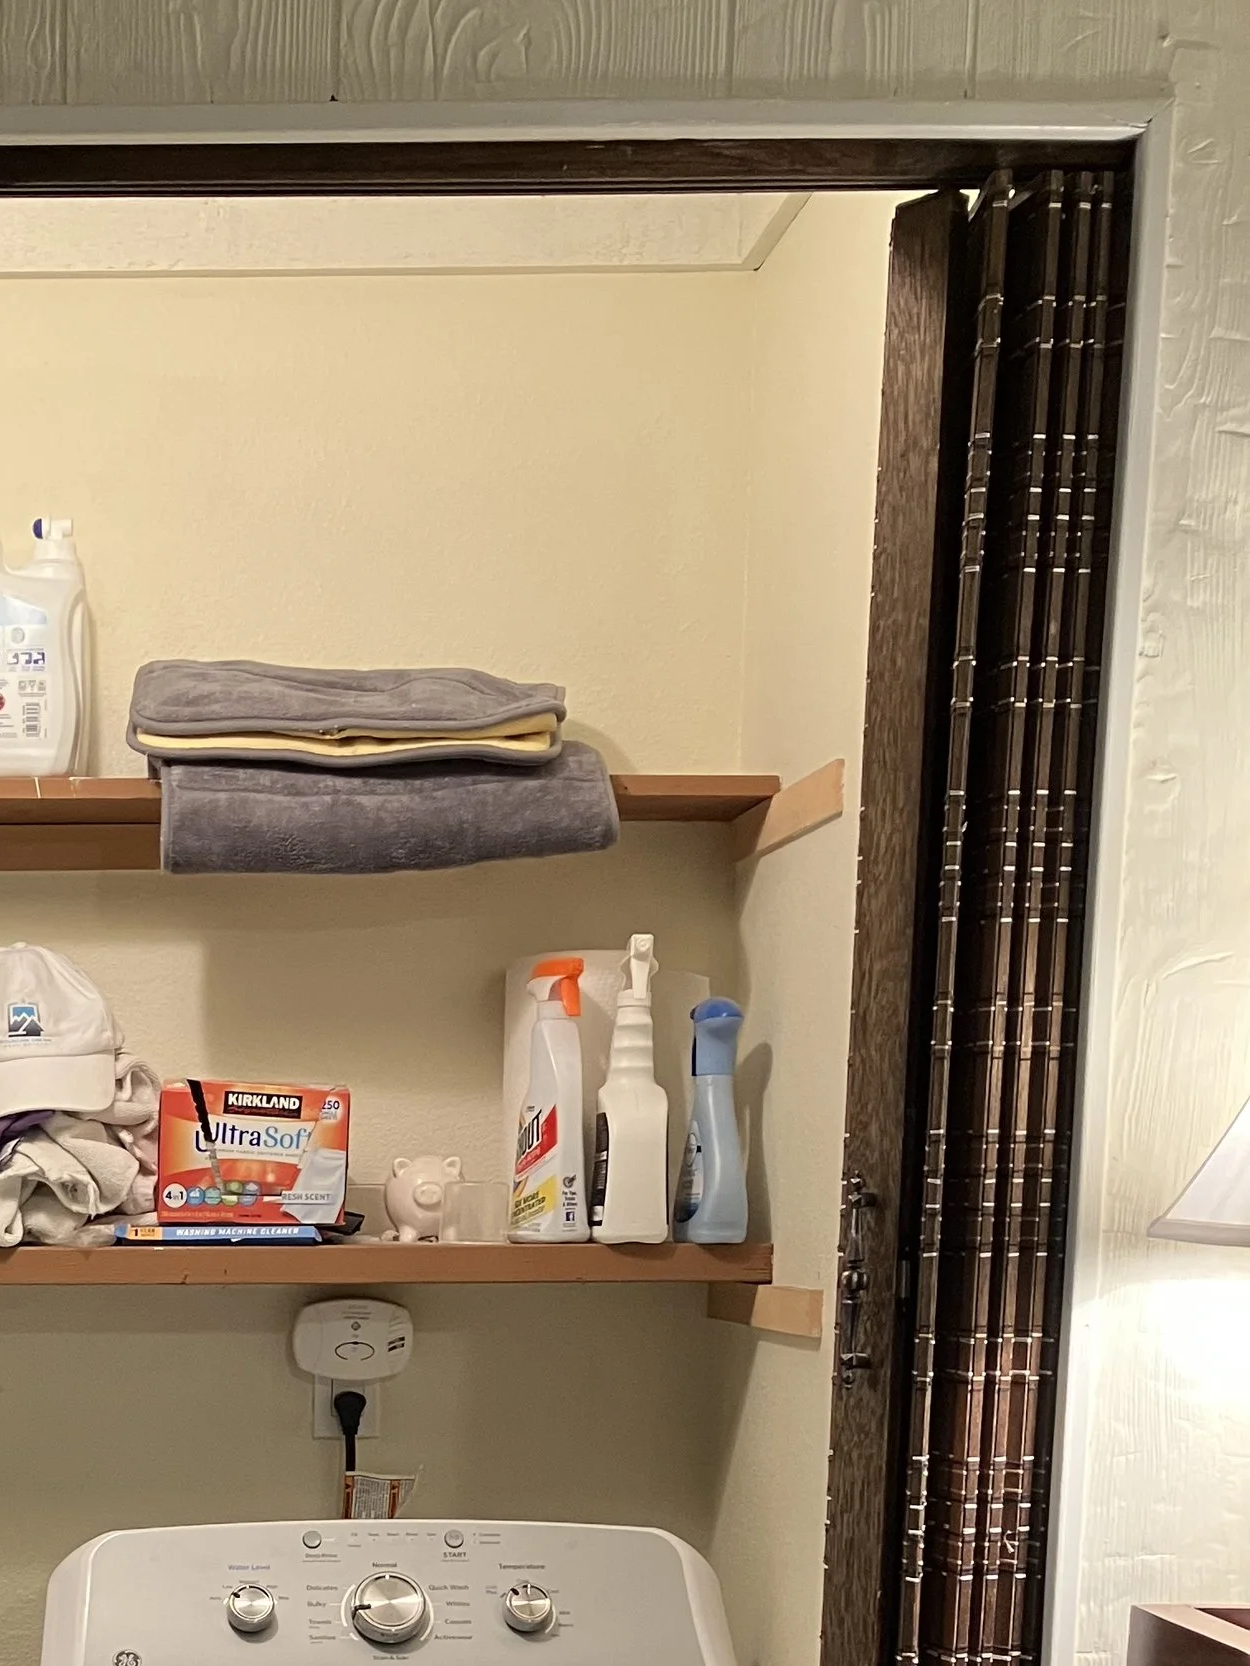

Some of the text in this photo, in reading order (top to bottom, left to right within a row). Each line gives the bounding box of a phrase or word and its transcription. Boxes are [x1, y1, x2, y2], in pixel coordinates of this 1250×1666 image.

[227, 1092, 300, 1110] KIRKLAND
[282, 1192, 330, 1201] RESH SCENT
[176, 1227, 299, 1236] WASHING MACHINE CLEANER
